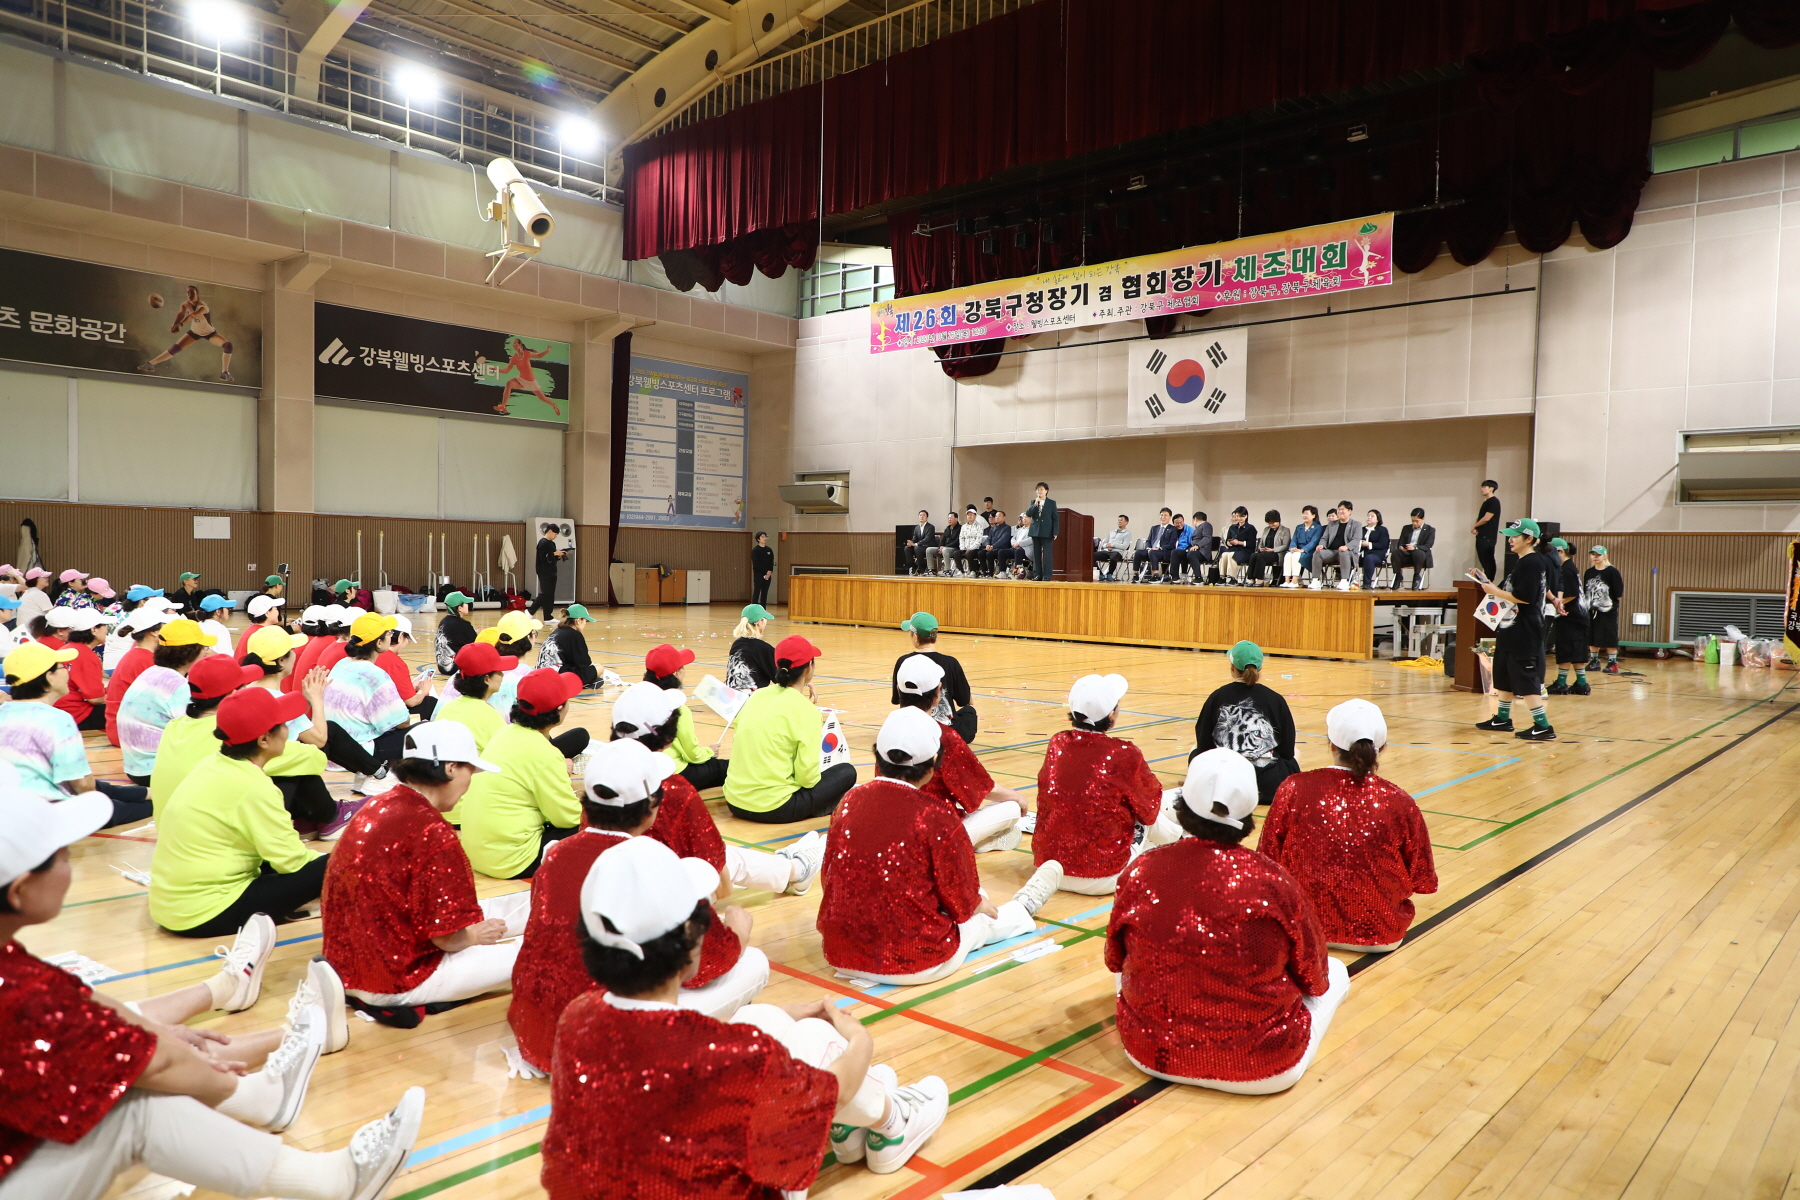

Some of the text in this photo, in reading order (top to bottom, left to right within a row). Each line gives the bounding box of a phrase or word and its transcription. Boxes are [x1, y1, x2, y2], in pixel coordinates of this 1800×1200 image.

[894, 241, 1348, 334] 제26회 강북구청장기 겸 협회장기 체조대회
[1223, 289, 1241, 302] 후원
[1282, 276, 1342, 295] 강북구체육회
[1140, 301, 1164, 314] 강북구
[1167, 294, 1200, 309] 체조협회
[29, 311, 127, 344] 문화공간
[1012, 322, 1025, 333] 장소
[1030, 313, 1076, 330] 웰빙스포츠센터
[359, 346, 500, 380] 강북웰빙스포츠센터
[700, 386, 731, 400] 프로그램
